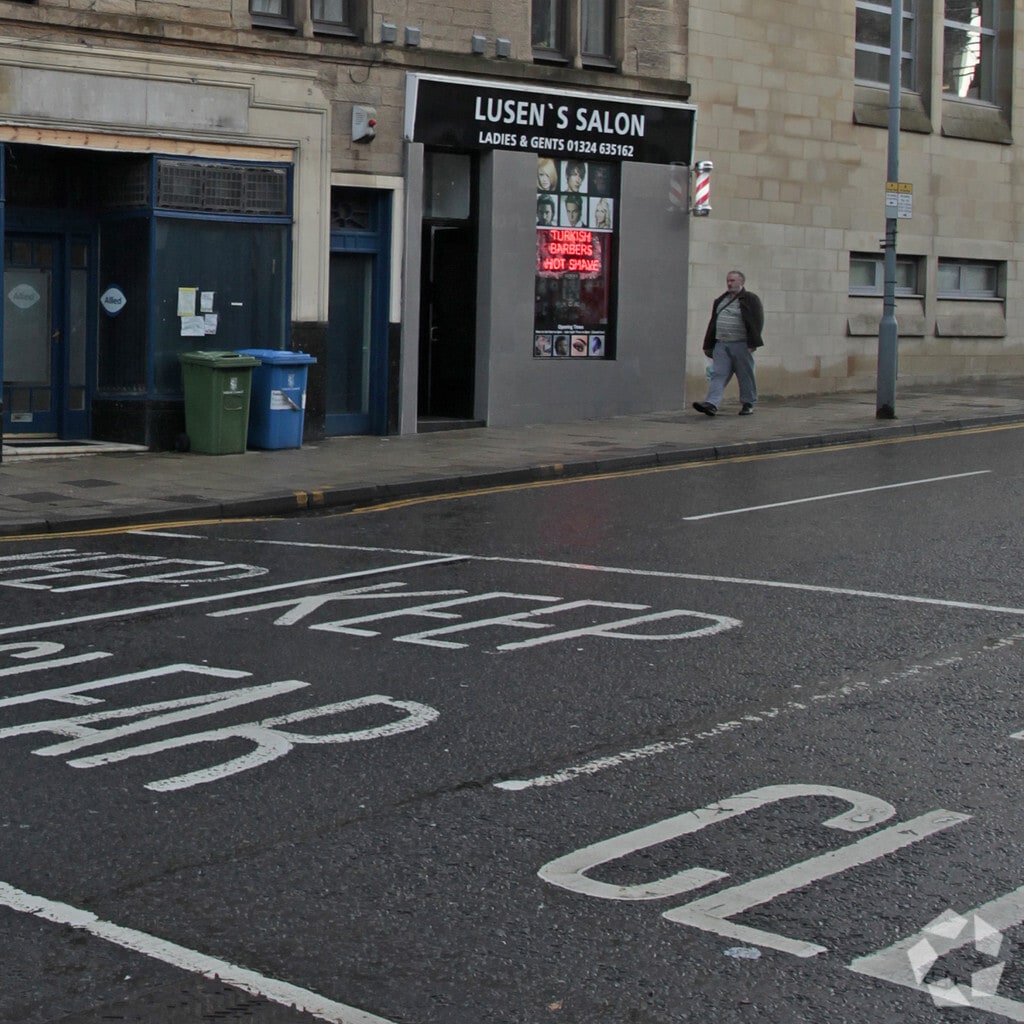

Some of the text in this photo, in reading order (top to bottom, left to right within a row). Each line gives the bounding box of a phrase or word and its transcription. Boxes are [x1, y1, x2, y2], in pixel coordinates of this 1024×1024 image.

[576, 108, 645, 137] SALON
[479, 131, 634, 157] LADIES & GENTS 01324 635162
[550, 230, 592, 242] TURKISH
[549, 242, 593, 256] BARBERS
[543, 258, 600, 272] HOT SHAVE
[104, 296, 122, 305] Allied
[206, 582, 743, 651] KEEP
